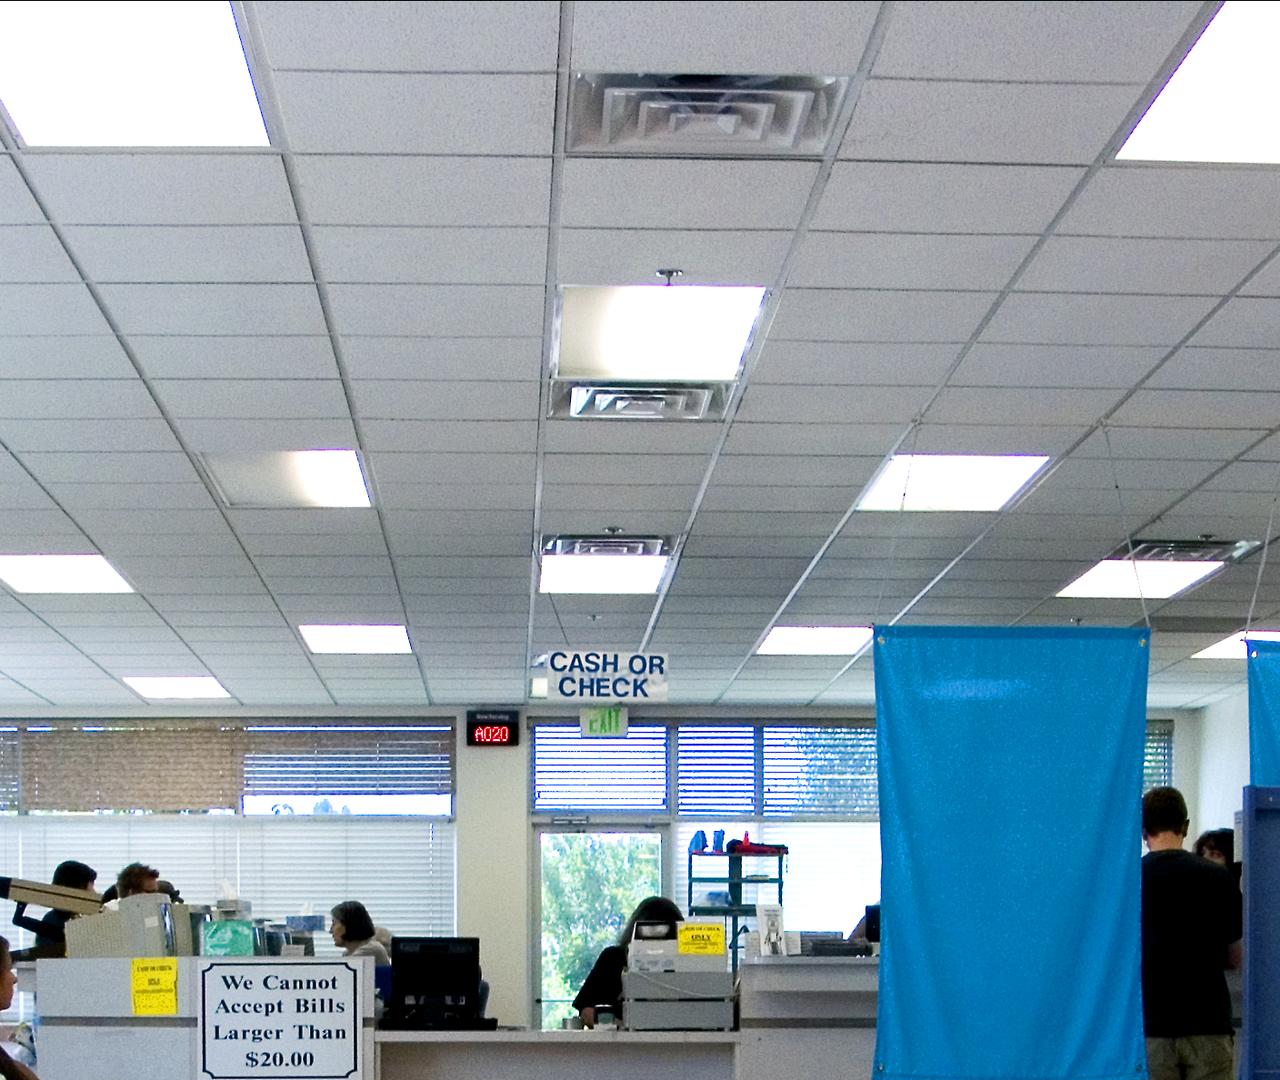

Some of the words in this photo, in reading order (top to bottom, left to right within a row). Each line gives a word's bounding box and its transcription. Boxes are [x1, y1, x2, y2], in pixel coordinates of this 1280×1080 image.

[550, 651, 619, 673] CASH
[628, 655, 665, 675] OR
[558, 676, 649, 698] CHECK
[474, 725, 509, 742] A020
[221, 975, 253, 990] We
[263, 974, 338, 990] Cannot
[215, 999, 283, 1017] Accept
[295, 998, 345, 1014] Bills
[213, 1024, 284, 1042] Larger
[293, 1024, 347, 1040] Than
[245, 1051, 314, 1068] $20.00
